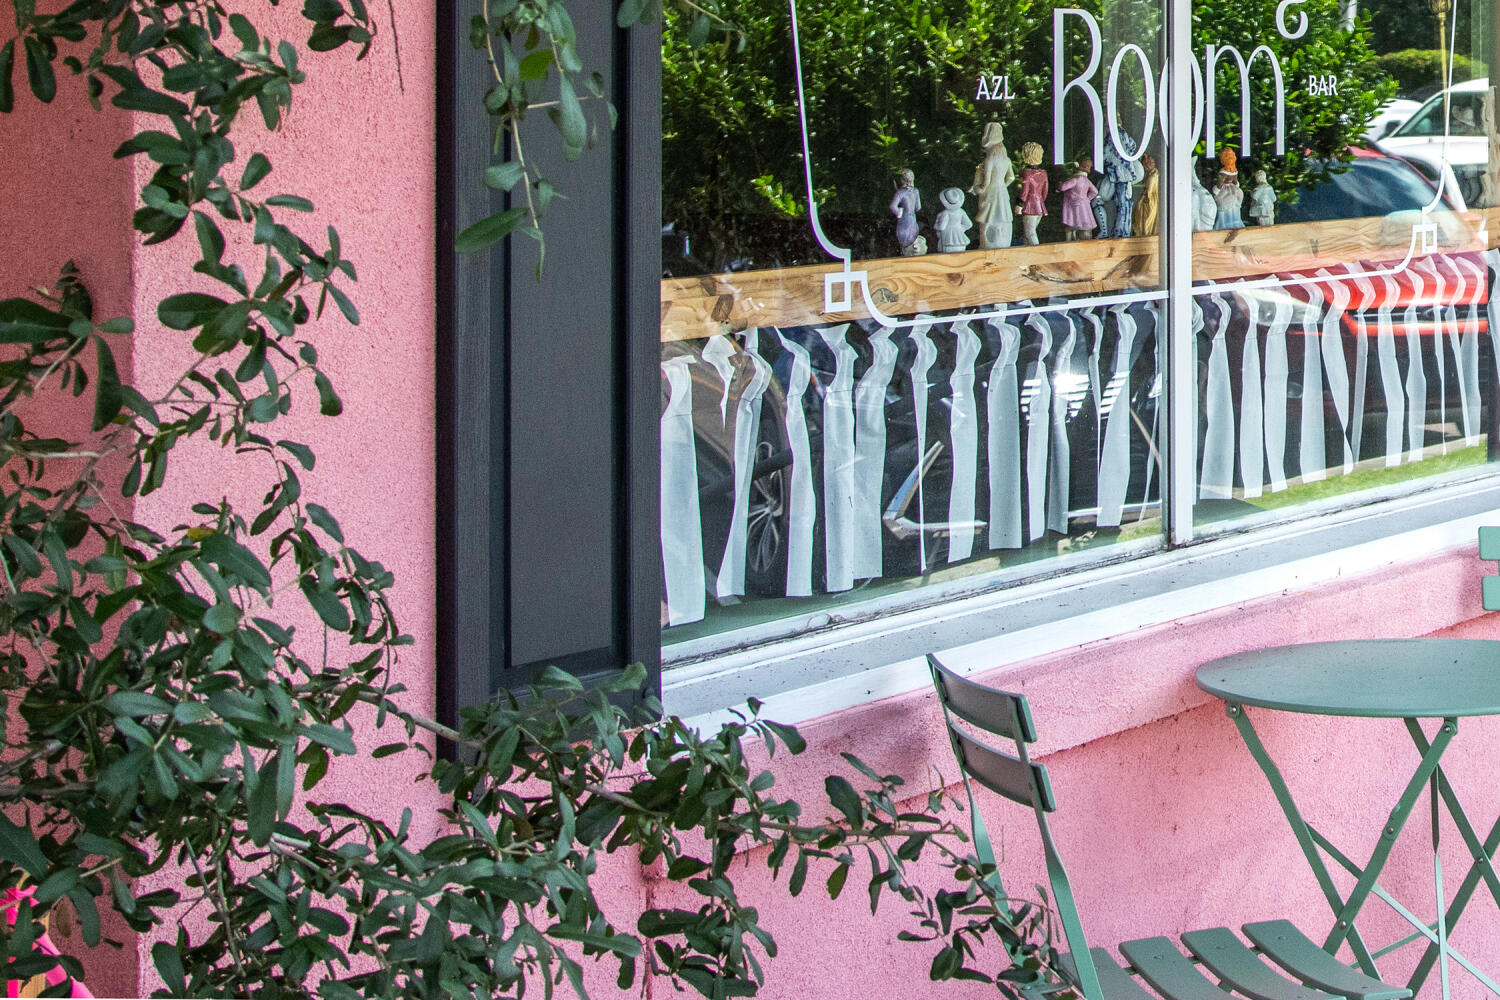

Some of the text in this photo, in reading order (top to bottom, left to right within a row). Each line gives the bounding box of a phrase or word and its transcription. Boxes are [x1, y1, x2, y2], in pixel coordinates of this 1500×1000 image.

[976, 75, 1016, 100] AZL
[1053, 7, 1285, 174] Room
[1308, 74, 1338, 96] BAR
